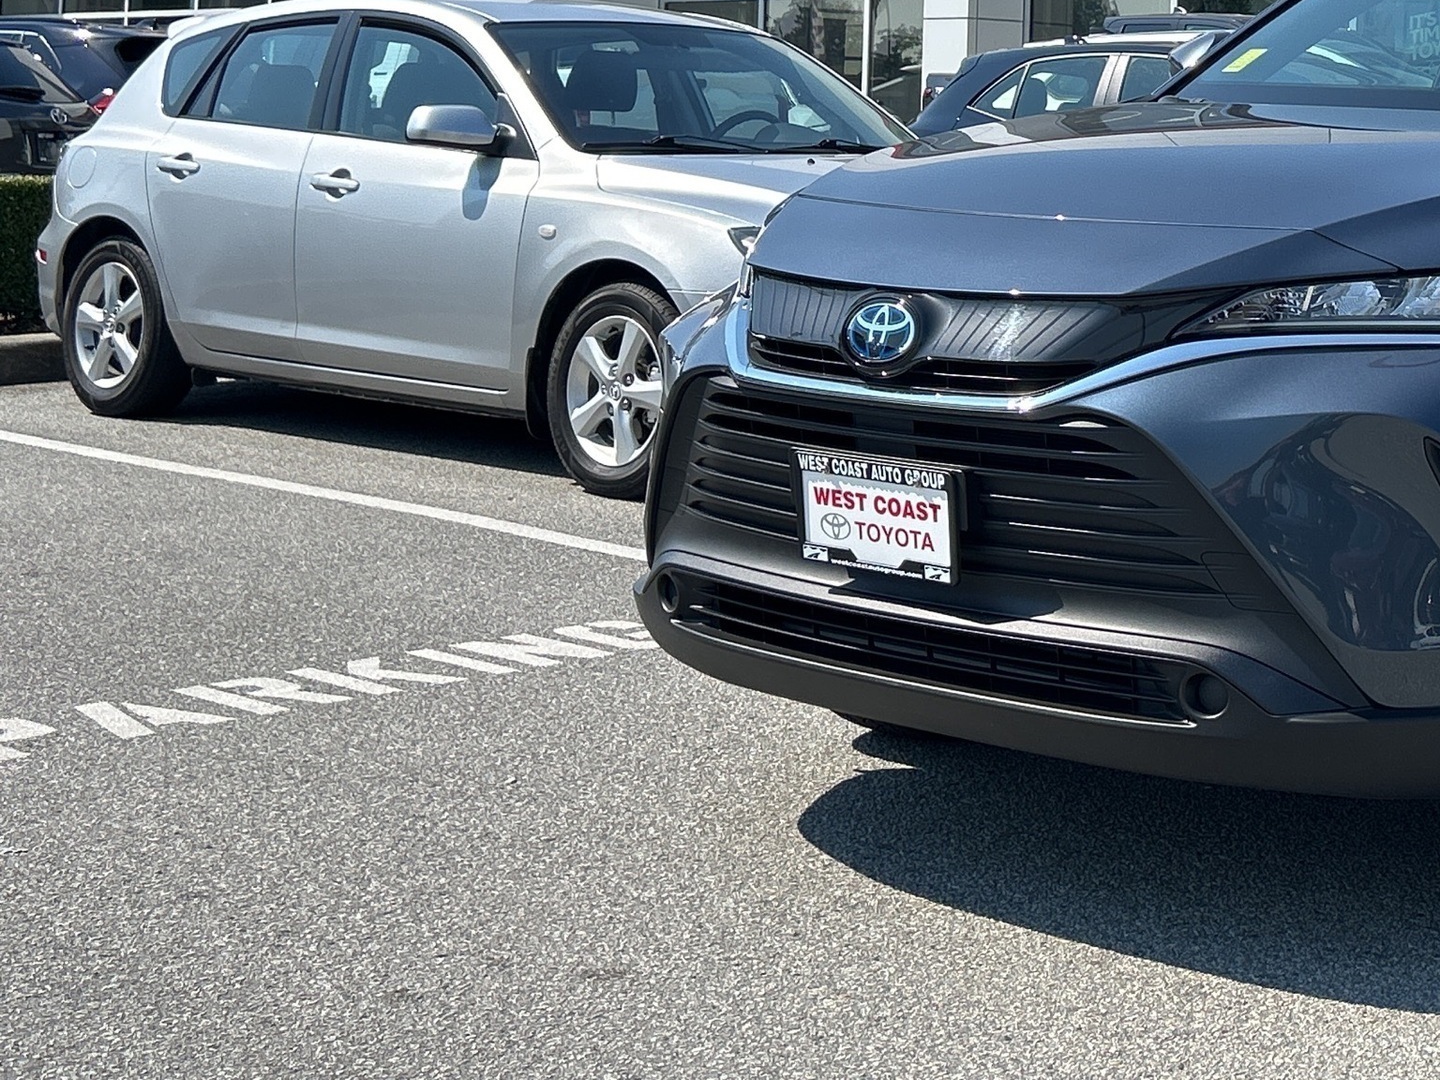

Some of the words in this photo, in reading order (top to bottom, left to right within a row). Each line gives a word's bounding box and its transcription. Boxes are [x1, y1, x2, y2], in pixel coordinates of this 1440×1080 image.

[797, 453, 829, 471] WEST
[832, 458, 868, 479] COAST
[871, 464, 902, 484] AUTO
[904, 470, 945, 490] GROUP
[813, 486, 867, 512] WEST
[873, 495, 941, 523] COAST
[854, 521, 935, 552] TOYOTA
